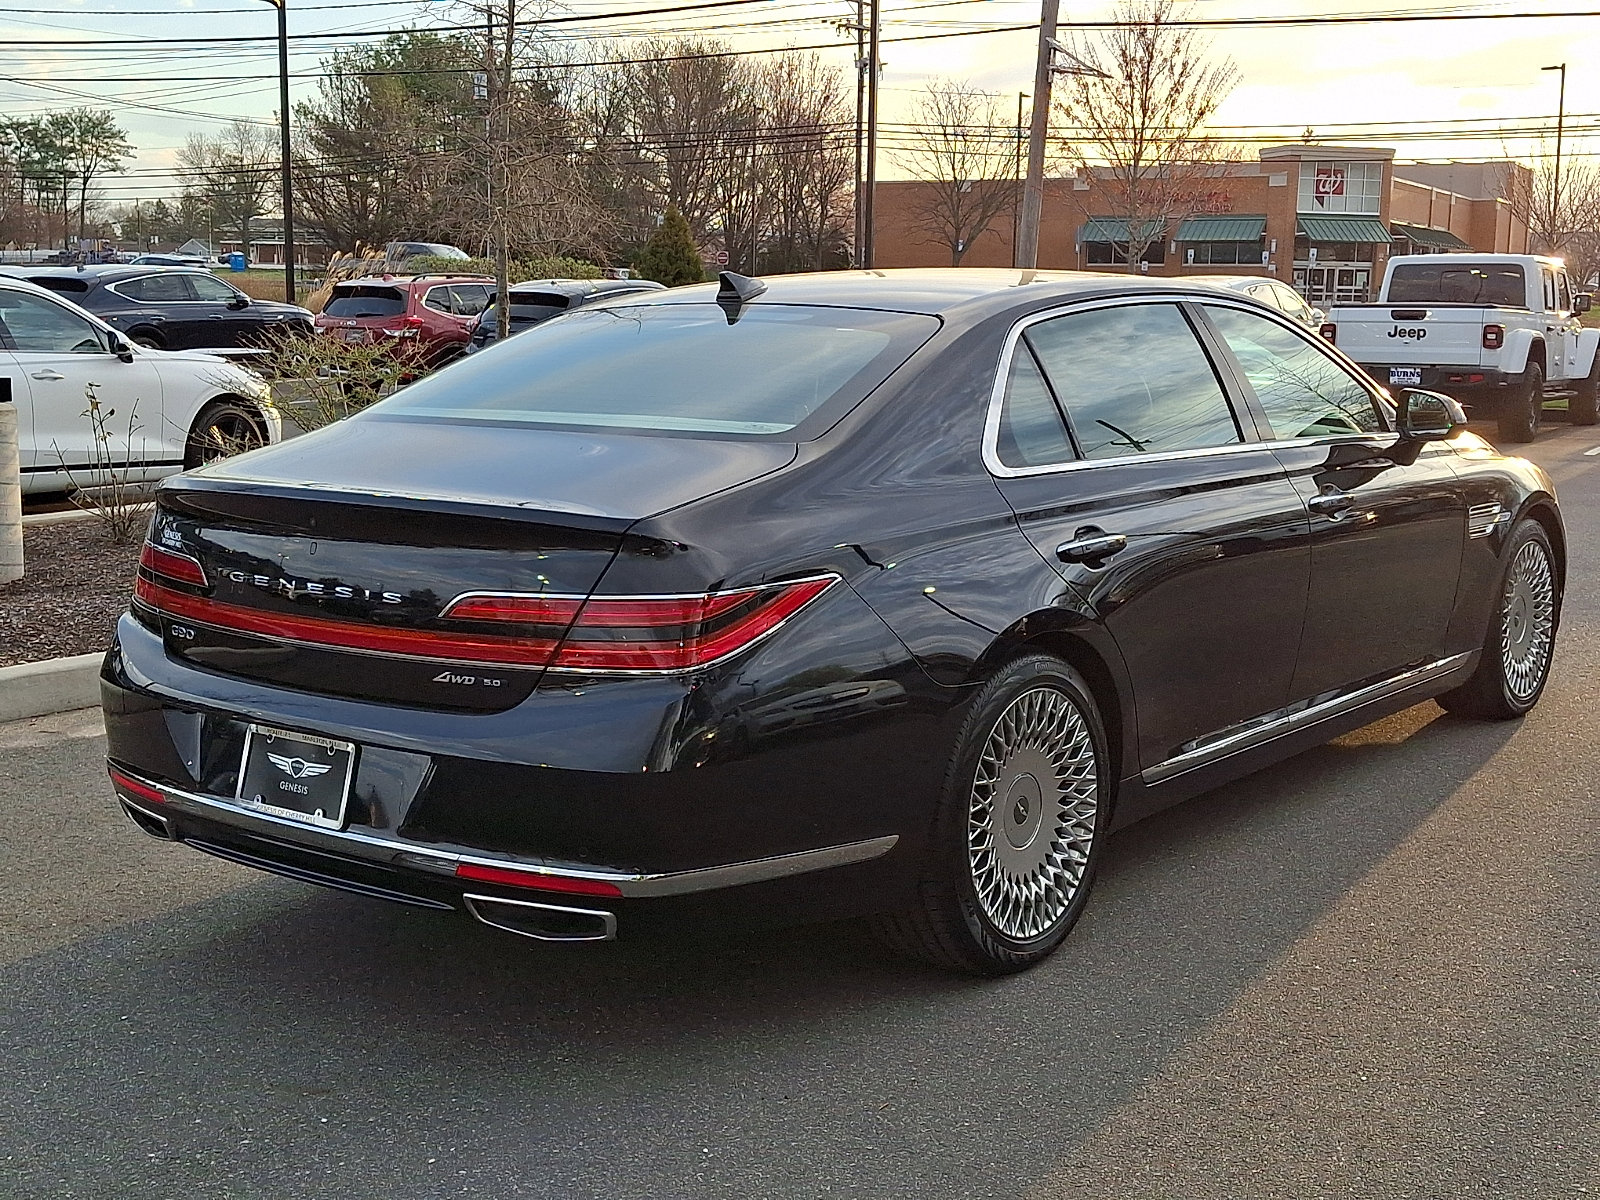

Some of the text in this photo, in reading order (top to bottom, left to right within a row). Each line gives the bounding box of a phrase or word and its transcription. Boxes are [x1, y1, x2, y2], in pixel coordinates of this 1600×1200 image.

[1387, 325, 1427, 341] Jeep
[1390, 370, 1421, 378] BURNS
[229, 571, 402, 604] GENESIS
[171, 624, 195, 640] G90
[432, 671, 501, 687] AWD 5.0
[280, 781, 308, 795] GENESIS
